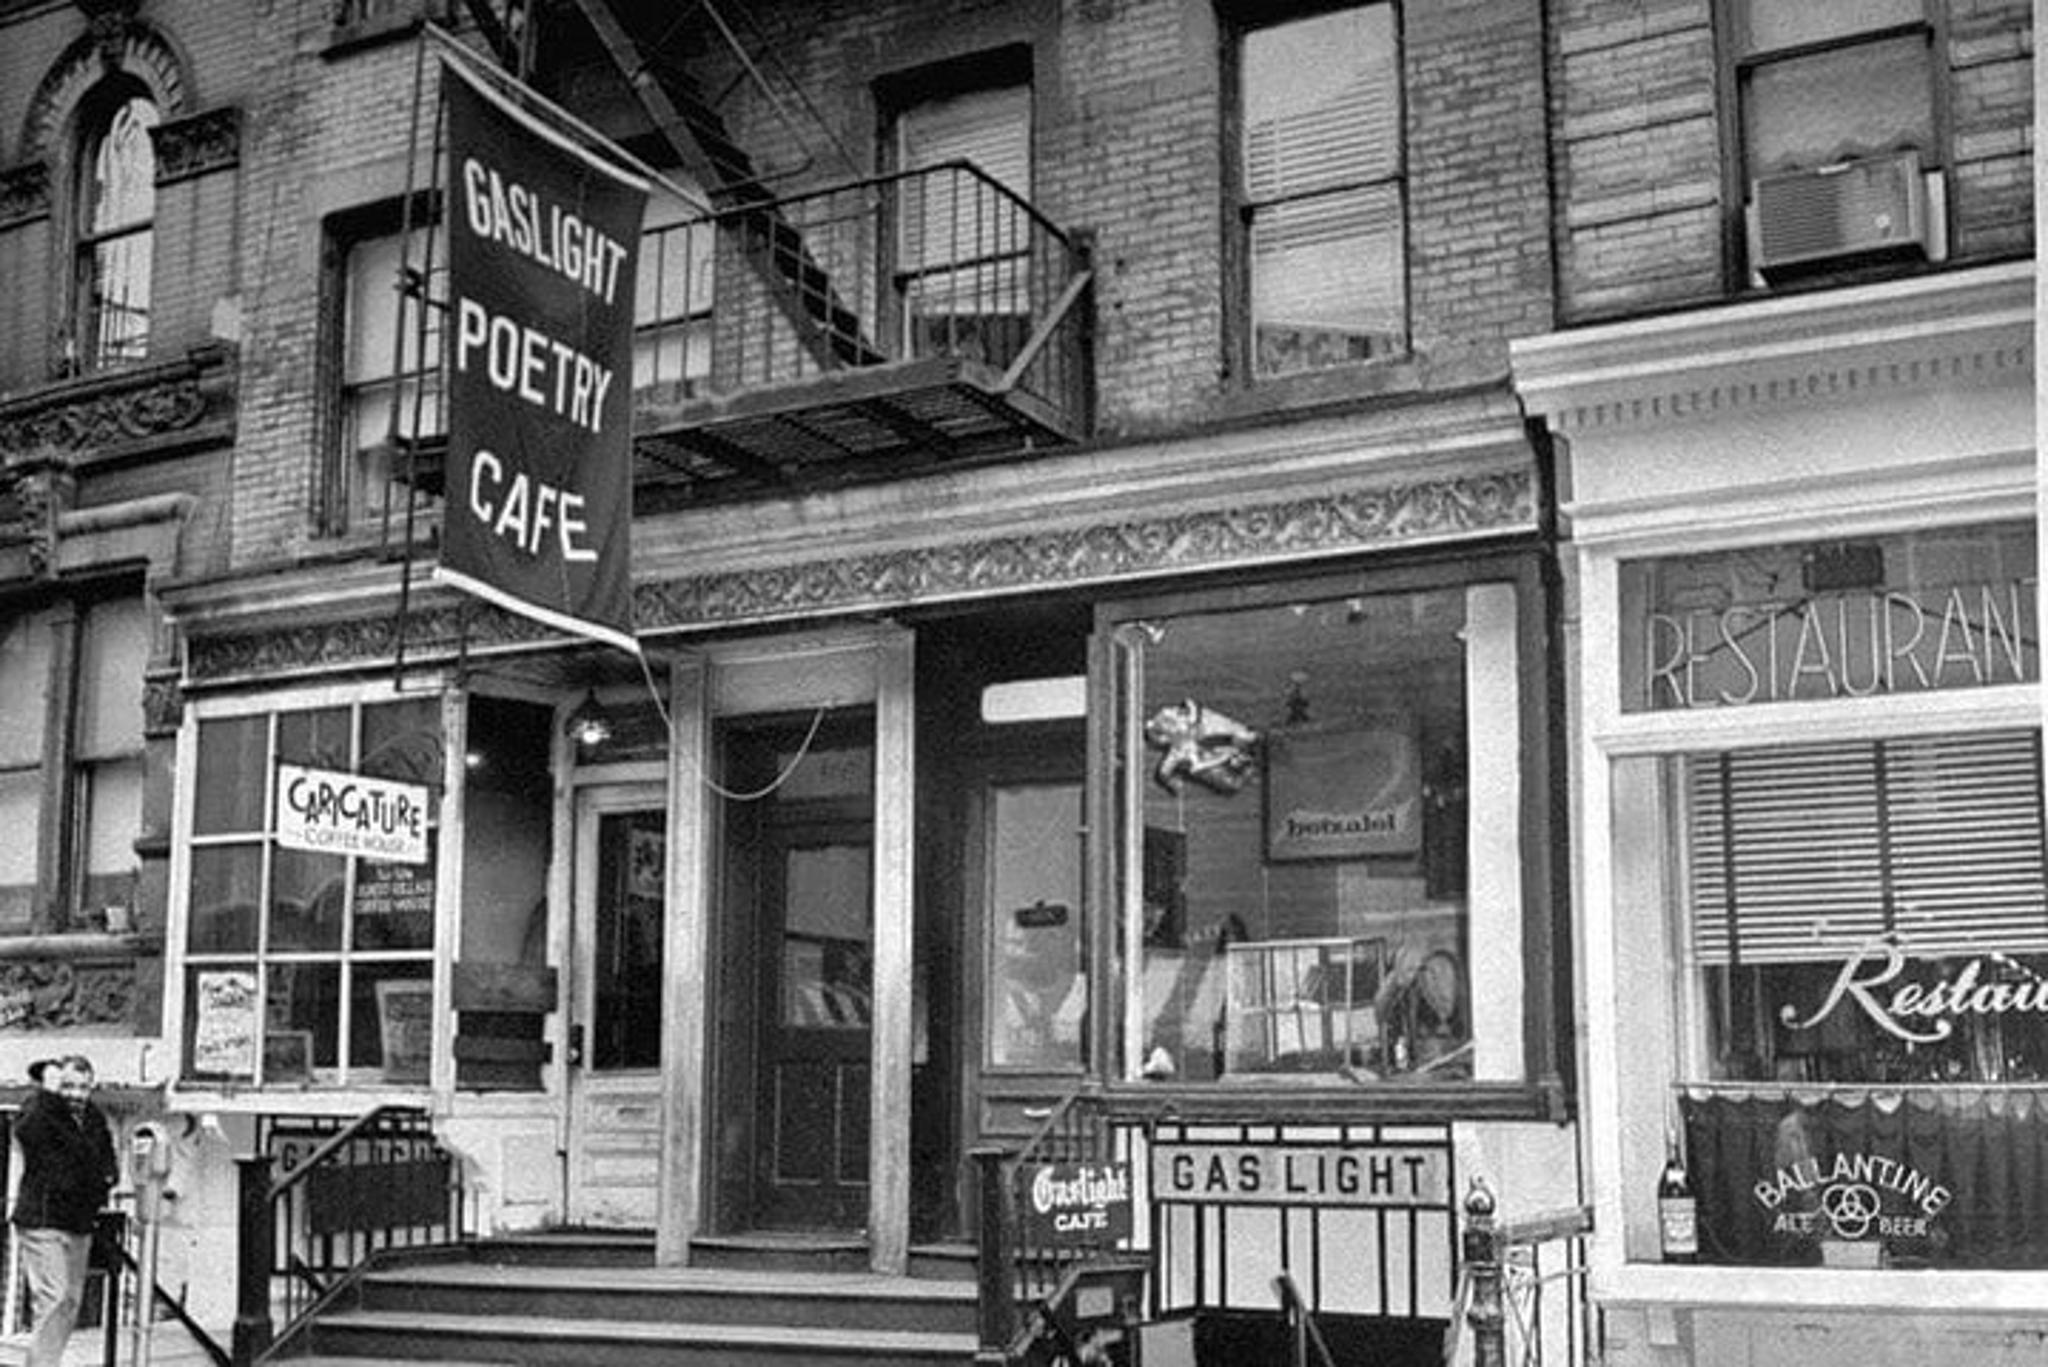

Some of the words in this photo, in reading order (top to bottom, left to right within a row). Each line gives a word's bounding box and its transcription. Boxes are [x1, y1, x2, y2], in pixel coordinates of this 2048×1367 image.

[463, 157, 628, 306] GASLIGHT
[457, 296, 613, 434] POETRY
[470, 450, 598, 562] CAFE
[287, 777, 421, 838] CARICATURE
[1033, 1166, 1128, 1213] Gaslight
[1172, 1154, 1261, 1192] GAS
[1284, 1155, 1425, 1195] LIGHT
[1754, 1152, 1951, 1214] BALLANTINE
[1054, 1212, 1109, 1232] CAFE
[1774, 1212, 1814, 1233] ALE
[1879, 1217, 1926, 1236] BEER
